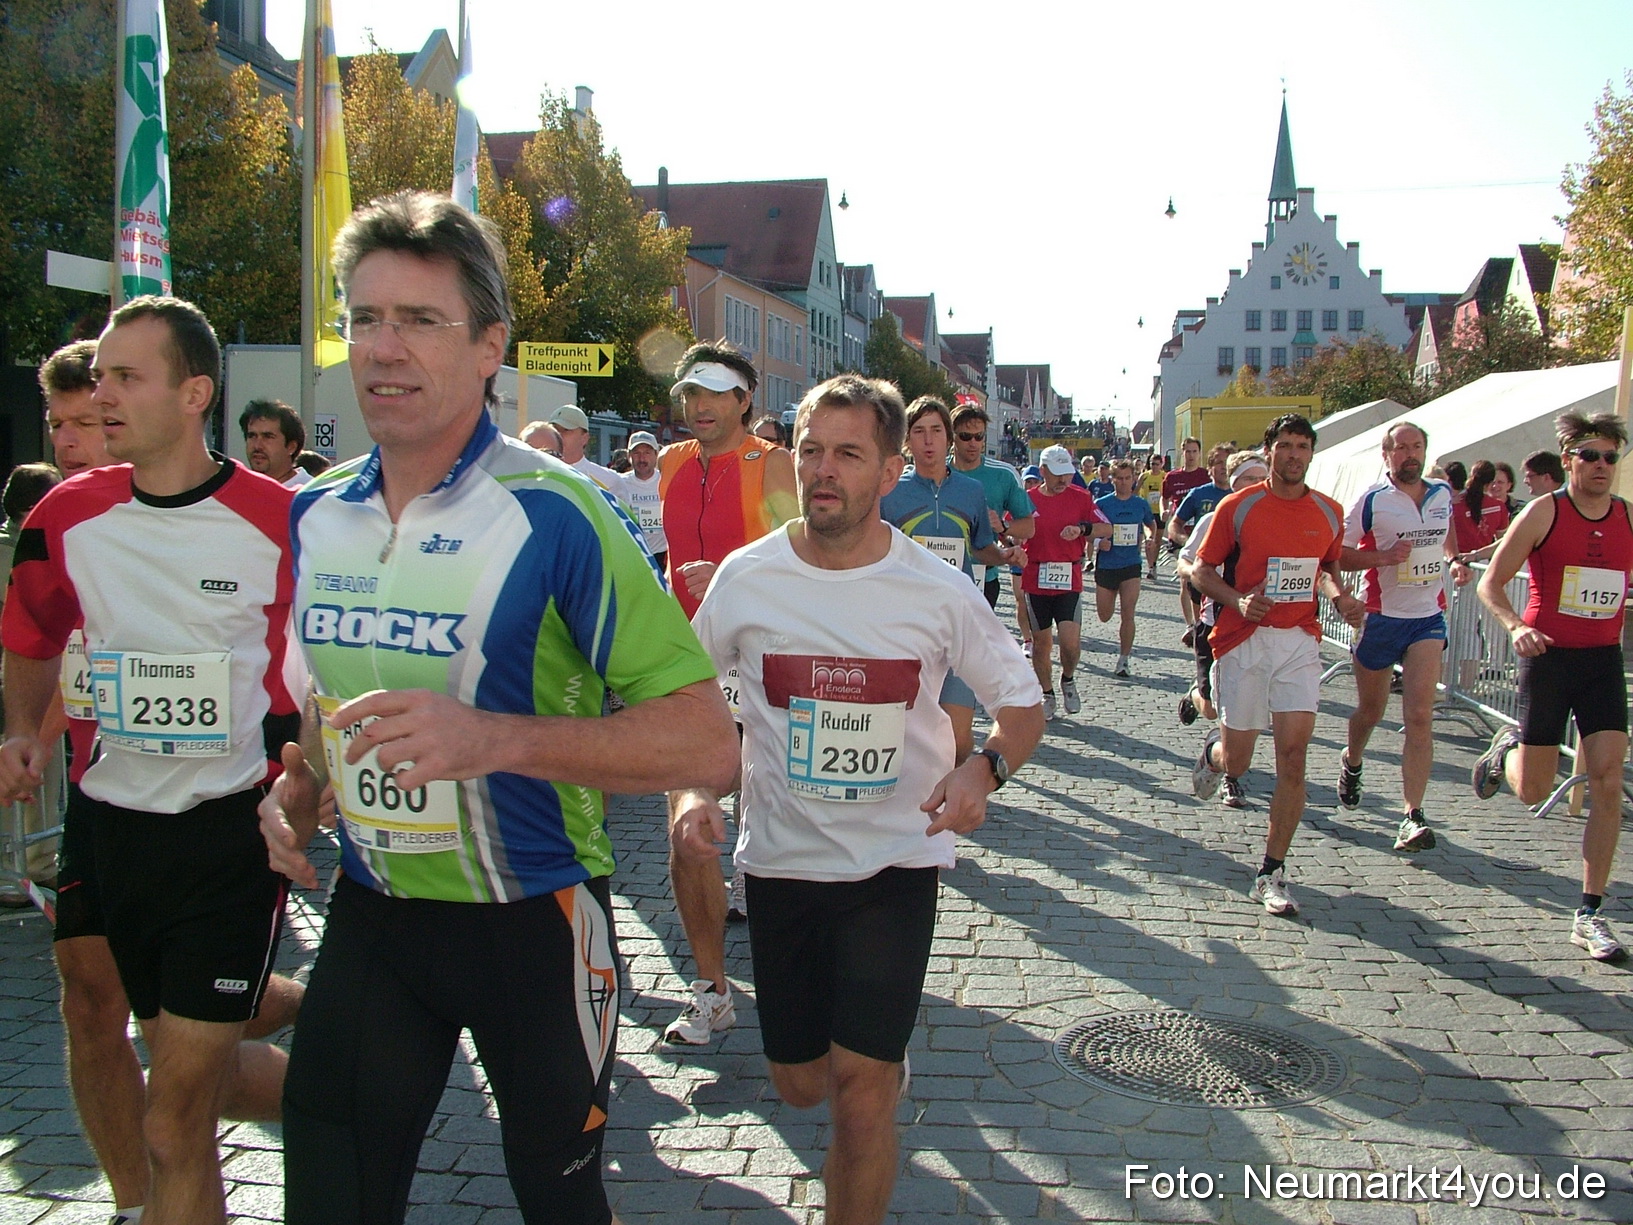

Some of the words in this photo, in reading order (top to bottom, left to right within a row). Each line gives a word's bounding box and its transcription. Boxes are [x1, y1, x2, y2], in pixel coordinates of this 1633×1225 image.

[525, 345, 588, 359] Treffpunkt
[525, 360, 592, 374] Bladenight
[315, 435, 334, 447] TOI
[926, 541, 956, 551] Matthias
[1281, 562, 1302, 571] Oliver
[1412, 561, 1441, 575] 1155
[314, 573, 378, 593] TEAM
[1048, 573, 1070, 582] 2277
[1280, 577, 1311, 590] 2699
[1581, 589, 1619, 605] 1157
[303, 603, 468, 657] BOCK
[128, 658, 195, 680] Thomas
[826, 684, 861, 694] Enoteca
[132, 696, 219, 727] 2338
[821, 711, 871, 733] Rudolf
[793, 736, 800, 749] B
[820, 746, 897, 775] 2307
[392, 831, 459, 844] PFLEIDERER
